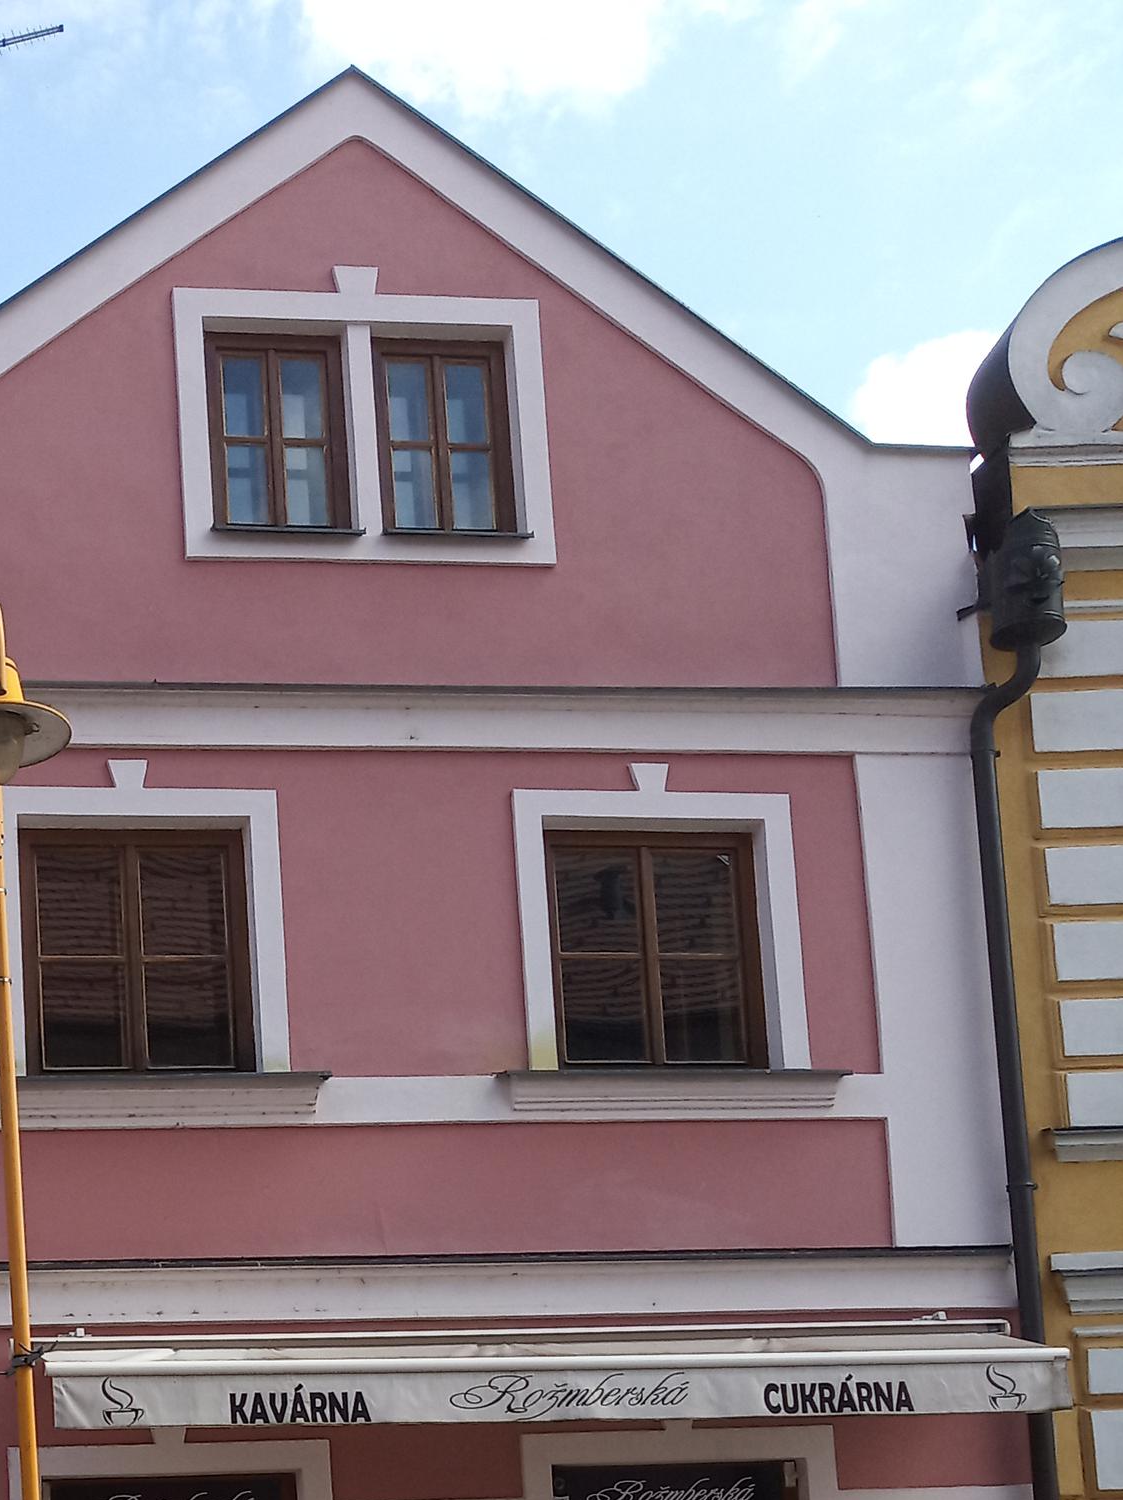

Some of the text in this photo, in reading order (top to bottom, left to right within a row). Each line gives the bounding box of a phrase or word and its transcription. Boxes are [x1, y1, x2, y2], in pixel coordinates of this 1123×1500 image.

[229, 1371, 915, 1424] KAVÁRNA Rožmberská CUKRÁRNA
